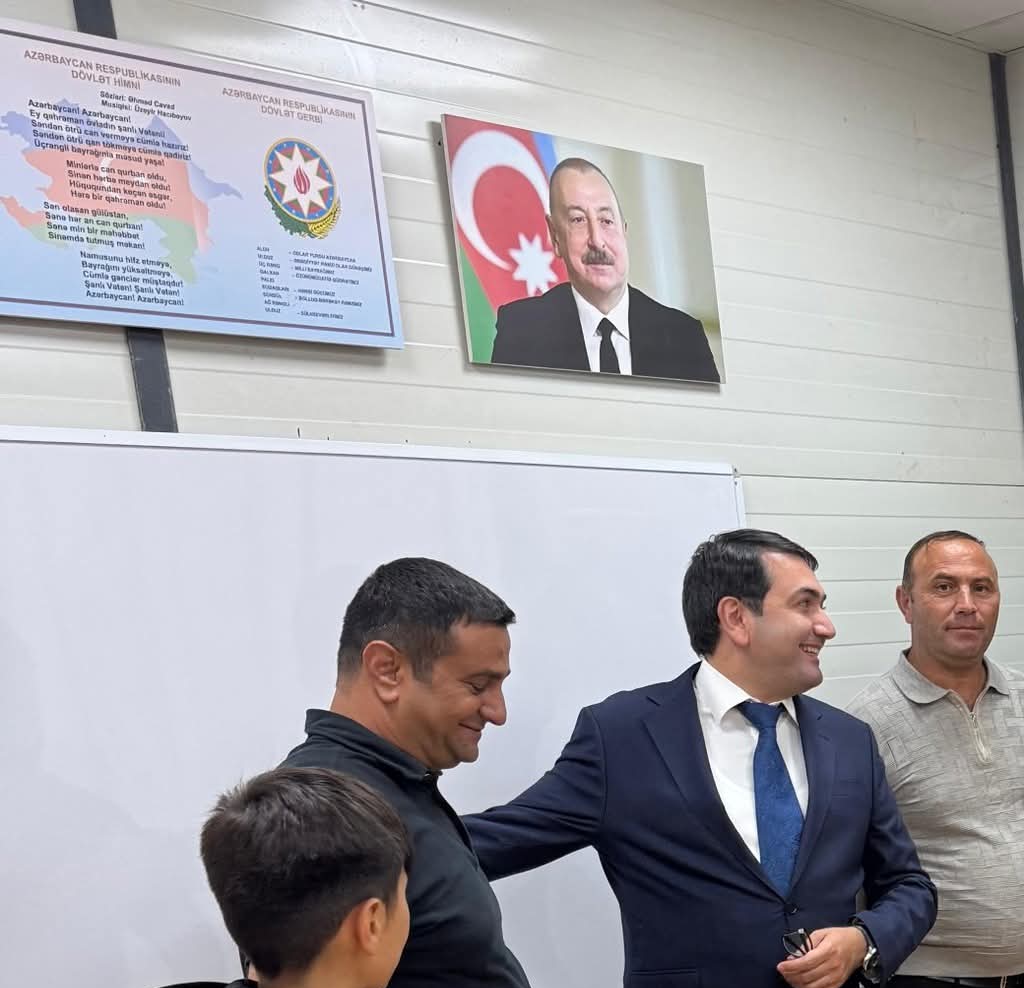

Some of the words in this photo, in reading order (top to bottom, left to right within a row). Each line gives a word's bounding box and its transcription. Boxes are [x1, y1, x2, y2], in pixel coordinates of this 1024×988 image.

[71, 70, 111, 85] DÖVLƏT
[29, 109, 40, 119] Ey
[84, 129, 99, 137] can
[100, 166, 115, 174] can
[92, 192, 103, 201] bir
[96, 219, 110, 227] can
